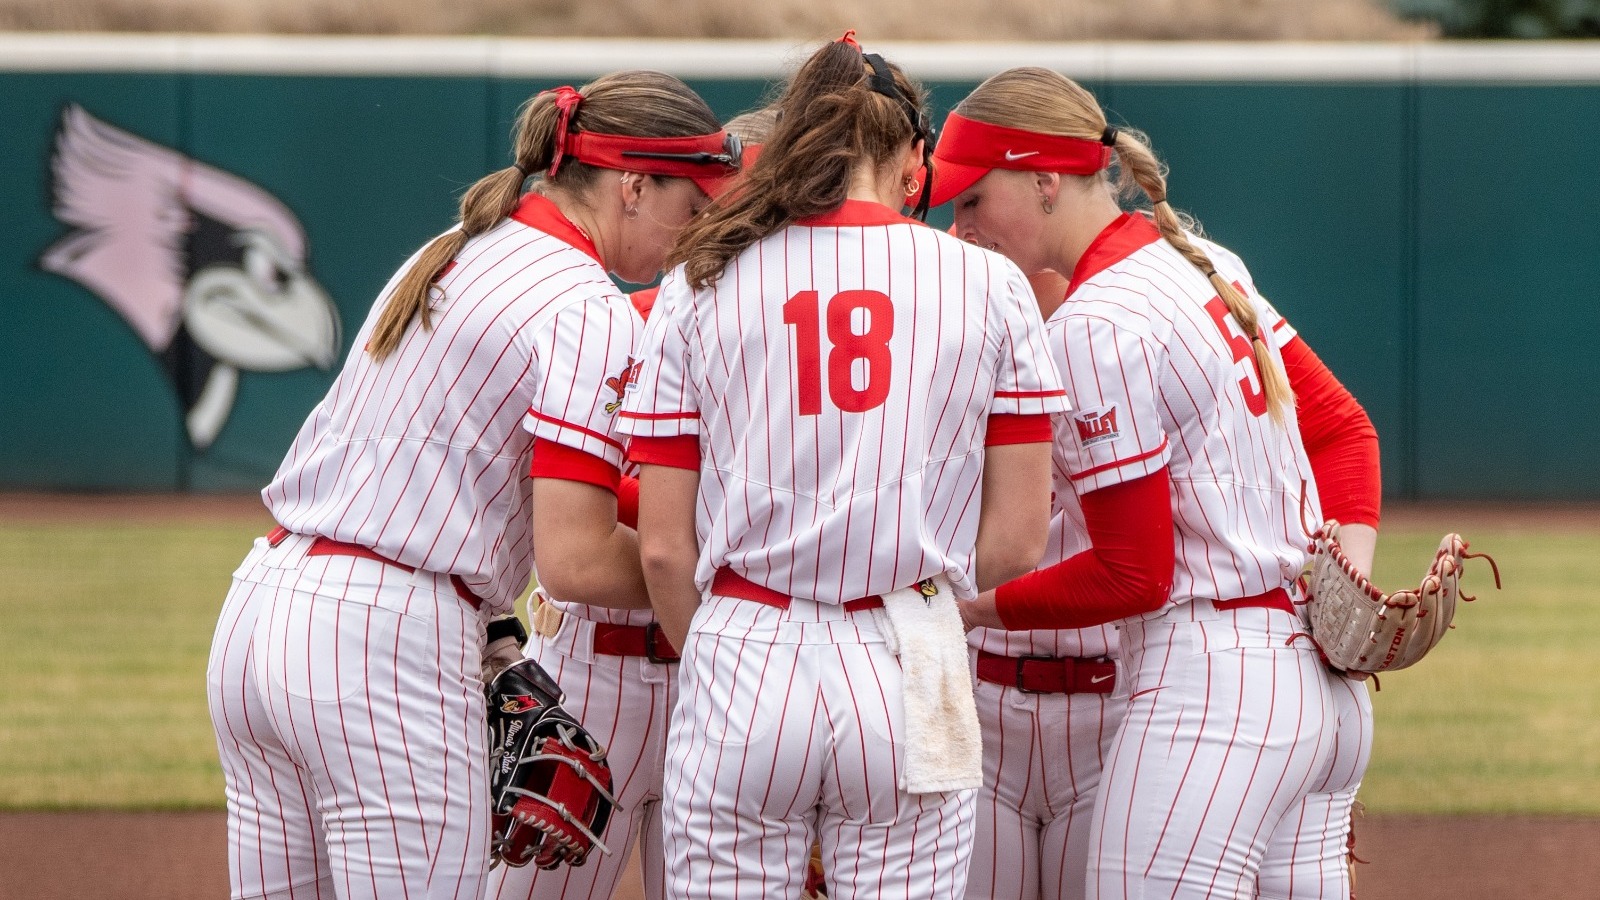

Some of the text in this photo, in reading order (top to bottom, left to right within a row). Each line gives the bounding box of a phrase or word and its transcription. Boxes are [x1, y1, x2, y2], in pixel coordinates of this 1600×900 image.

[782, 289, 895, 416] 18
[1378, 627, 1406, 669] EASTON
[502, 720, 523, 774] Illinois State
